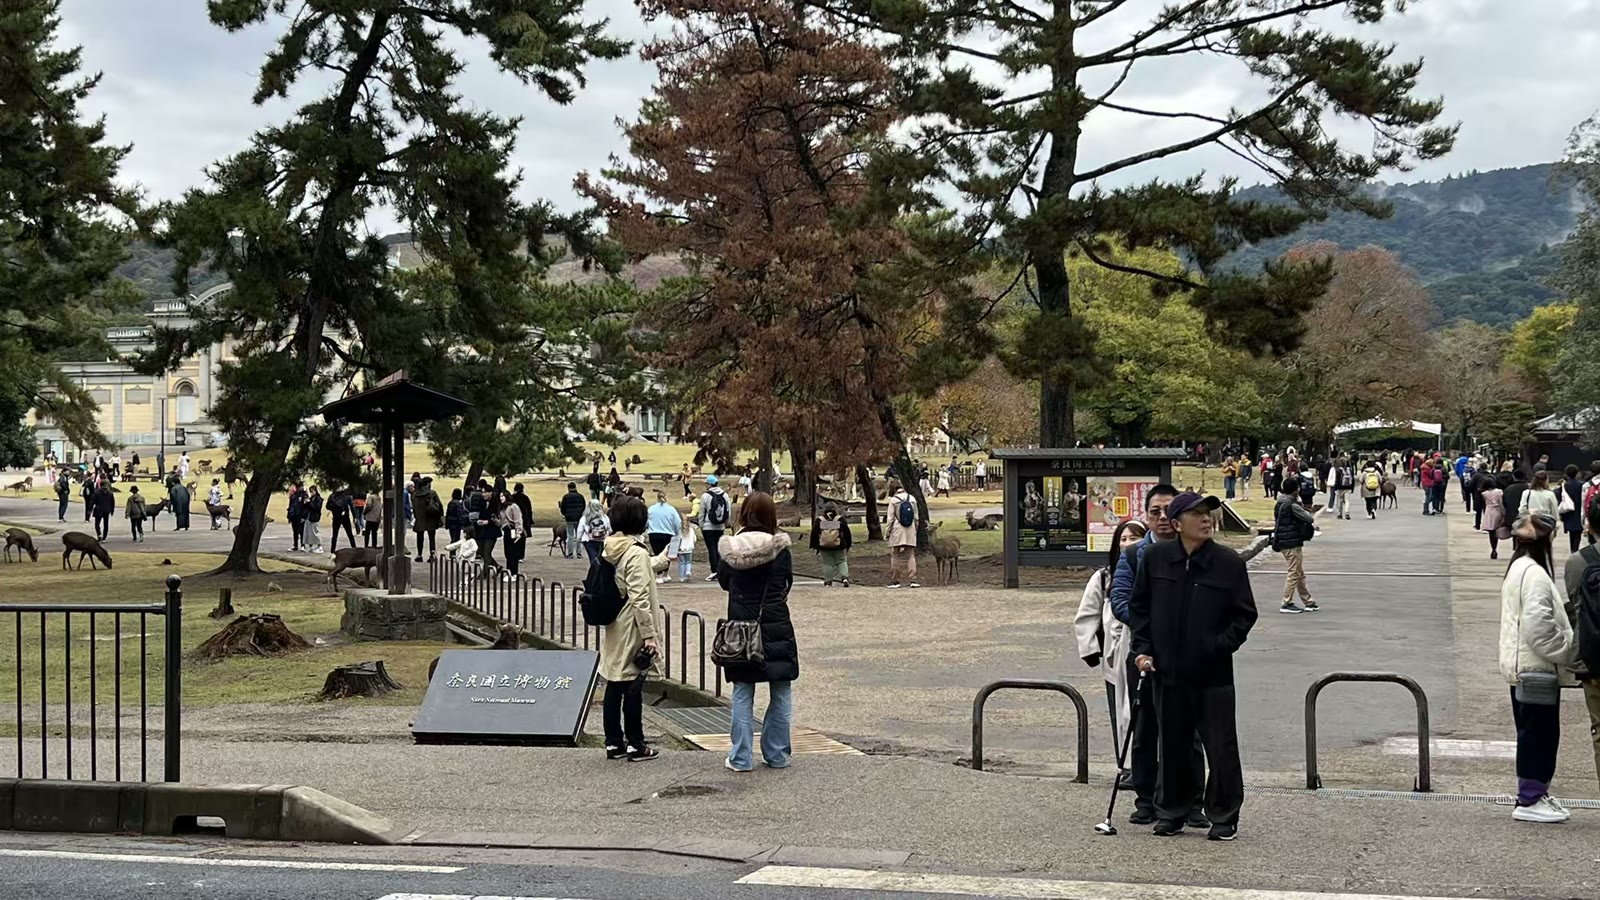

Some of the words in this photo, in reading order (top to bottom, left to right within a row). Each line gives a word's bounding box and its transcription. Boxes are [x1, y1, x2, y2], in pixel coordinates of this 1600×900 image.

[1051, 459, 1125, 469] 奈良国立博物館
[484, 696, 510, 704] National
